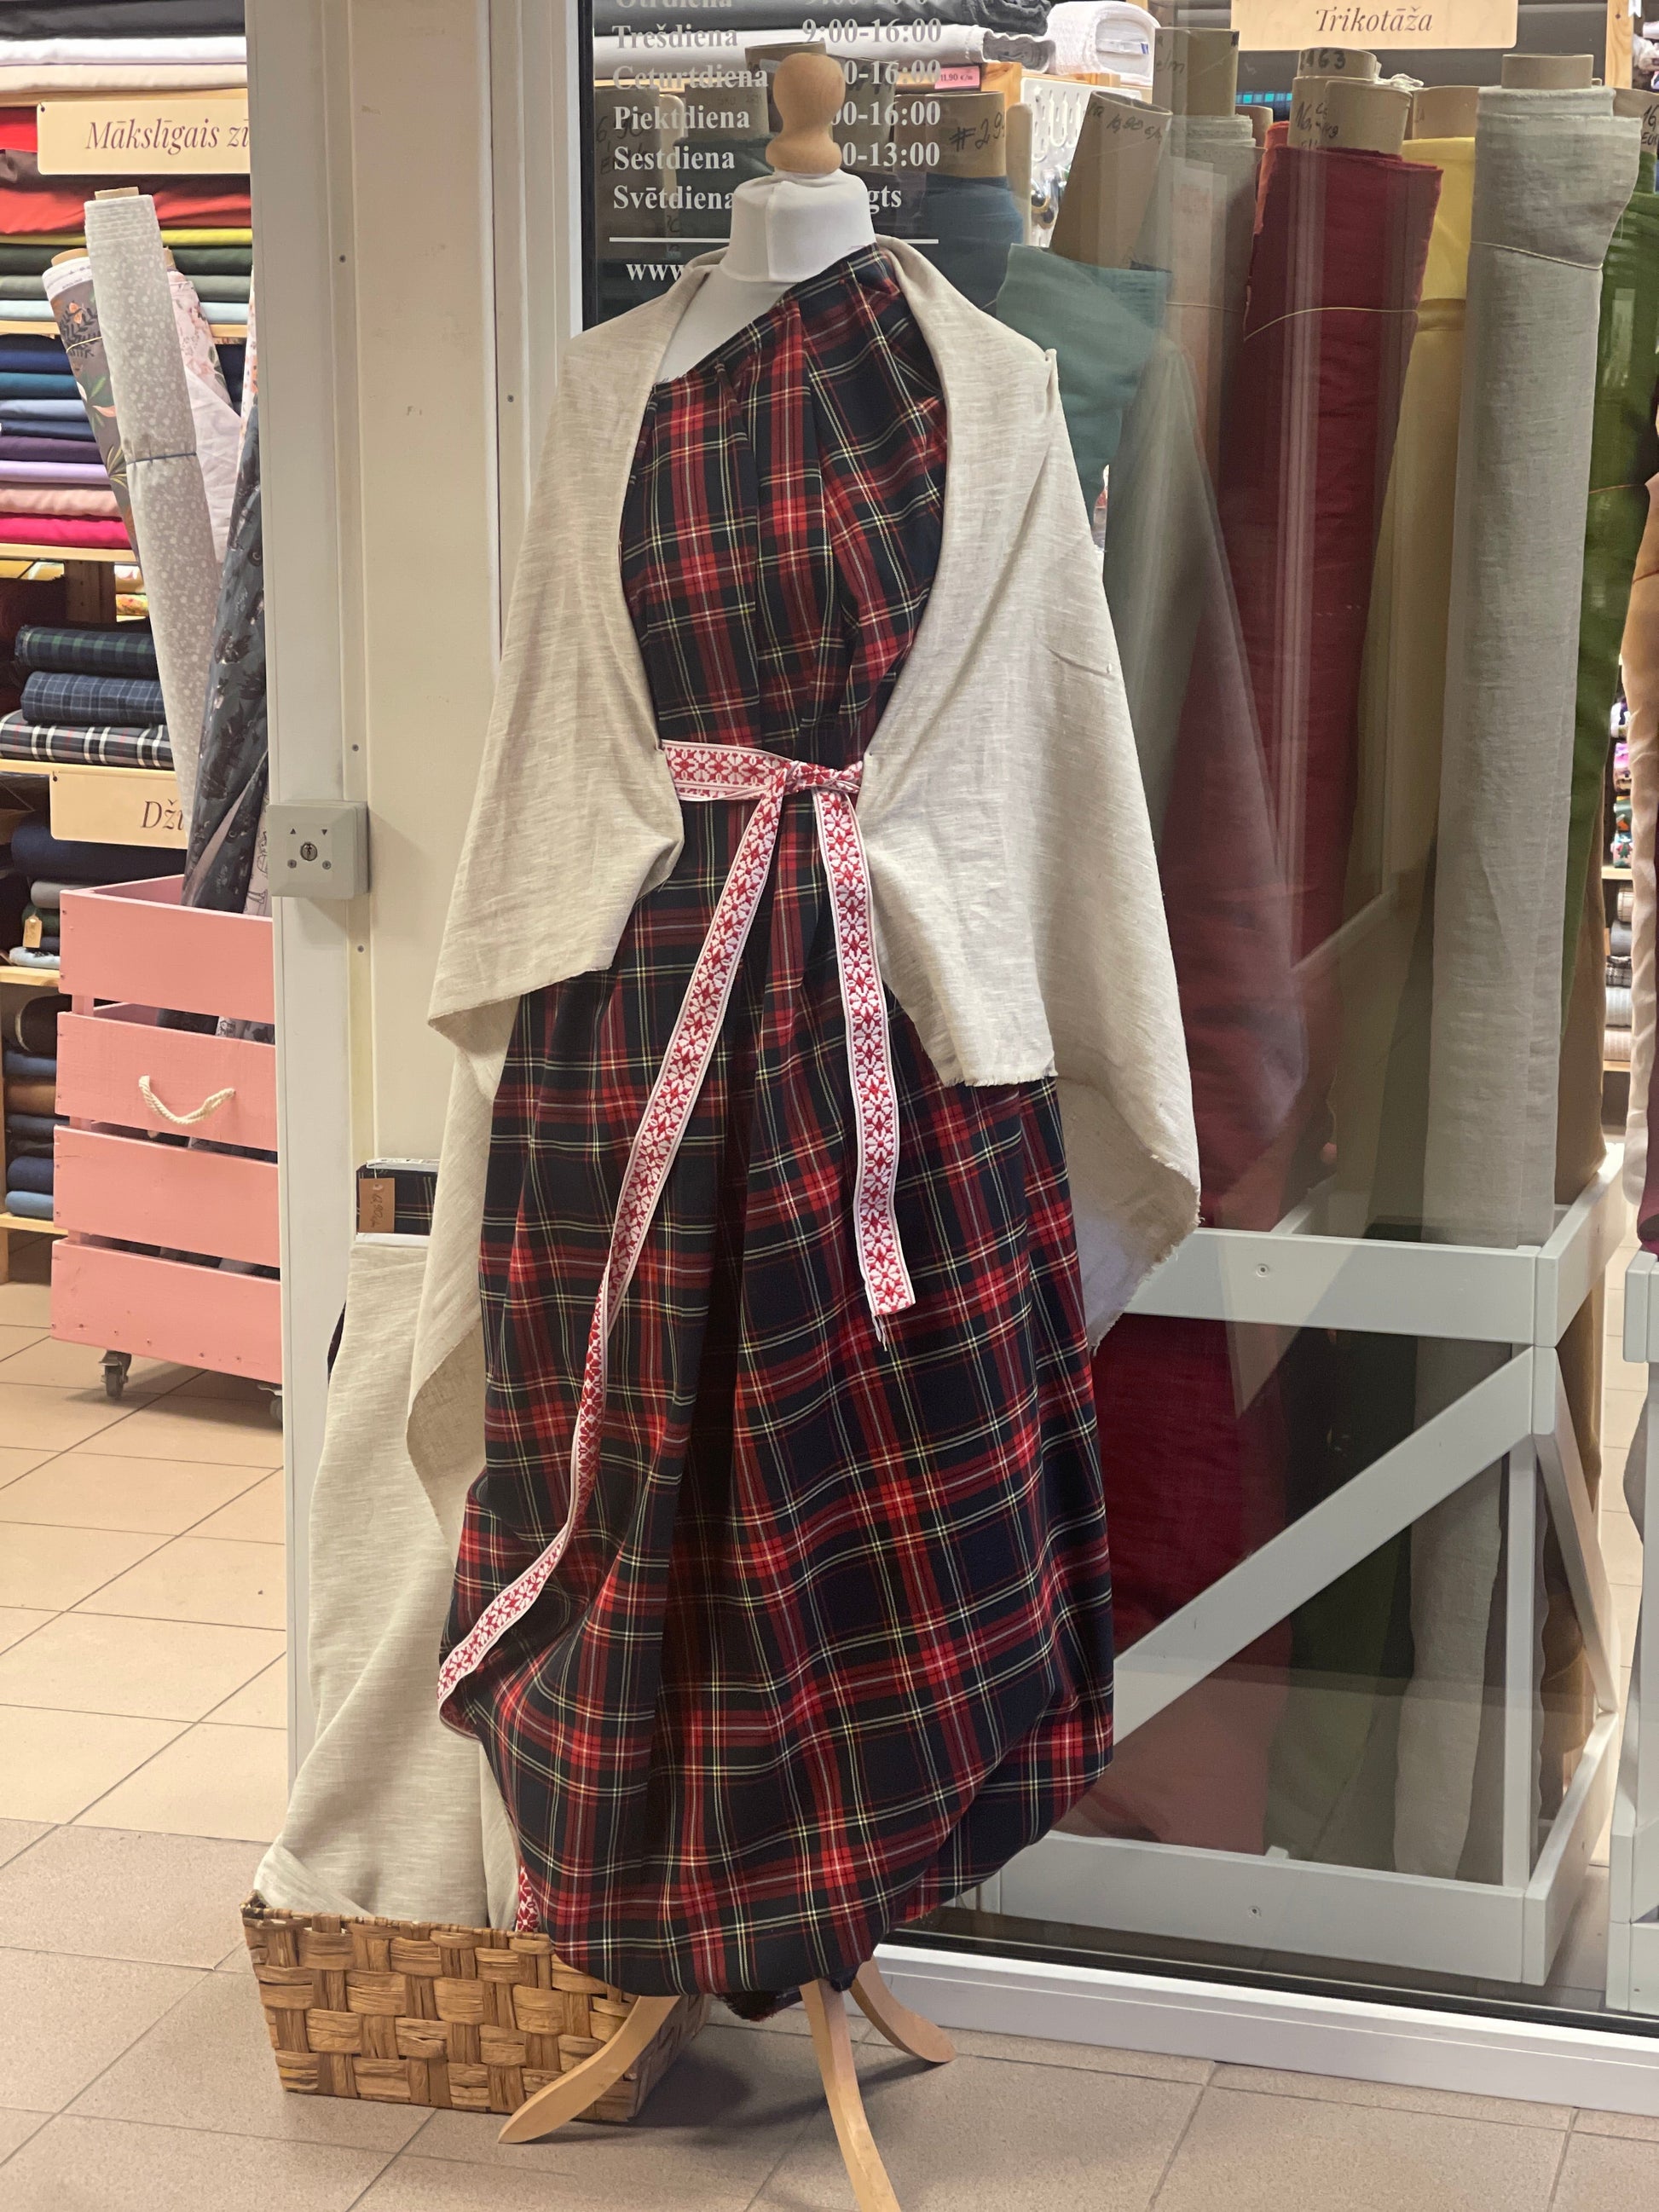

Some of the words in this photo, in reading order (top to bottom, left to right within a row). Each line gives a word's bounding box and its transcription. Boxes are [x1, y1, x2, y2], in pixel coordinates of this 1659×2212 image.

[611, 23, 738, 49] Trešdiena
[801, 17, 942, 43] 9:00-16:00
[1315, 6, 1433, 32] Trikotāža
[612, 64, 769, 90] Ceturtdiena
[844, 60, 941, 85] 0-16:00
[613, 105, 750, 130] Piektdiena
[831, 101, 941, 126] 0-16:00
[84, 118, 220, 156] Mākslīgais
[227, 118, 250, 148] zī
[614, 145, 736, 171] Sestdiena
[842, 141, 940, 166] 0-13:00
[613, 184, 735, 211] Svētdiena
[868, 185, 903, 215] gts
[140, 798, 185, 831] Dži
